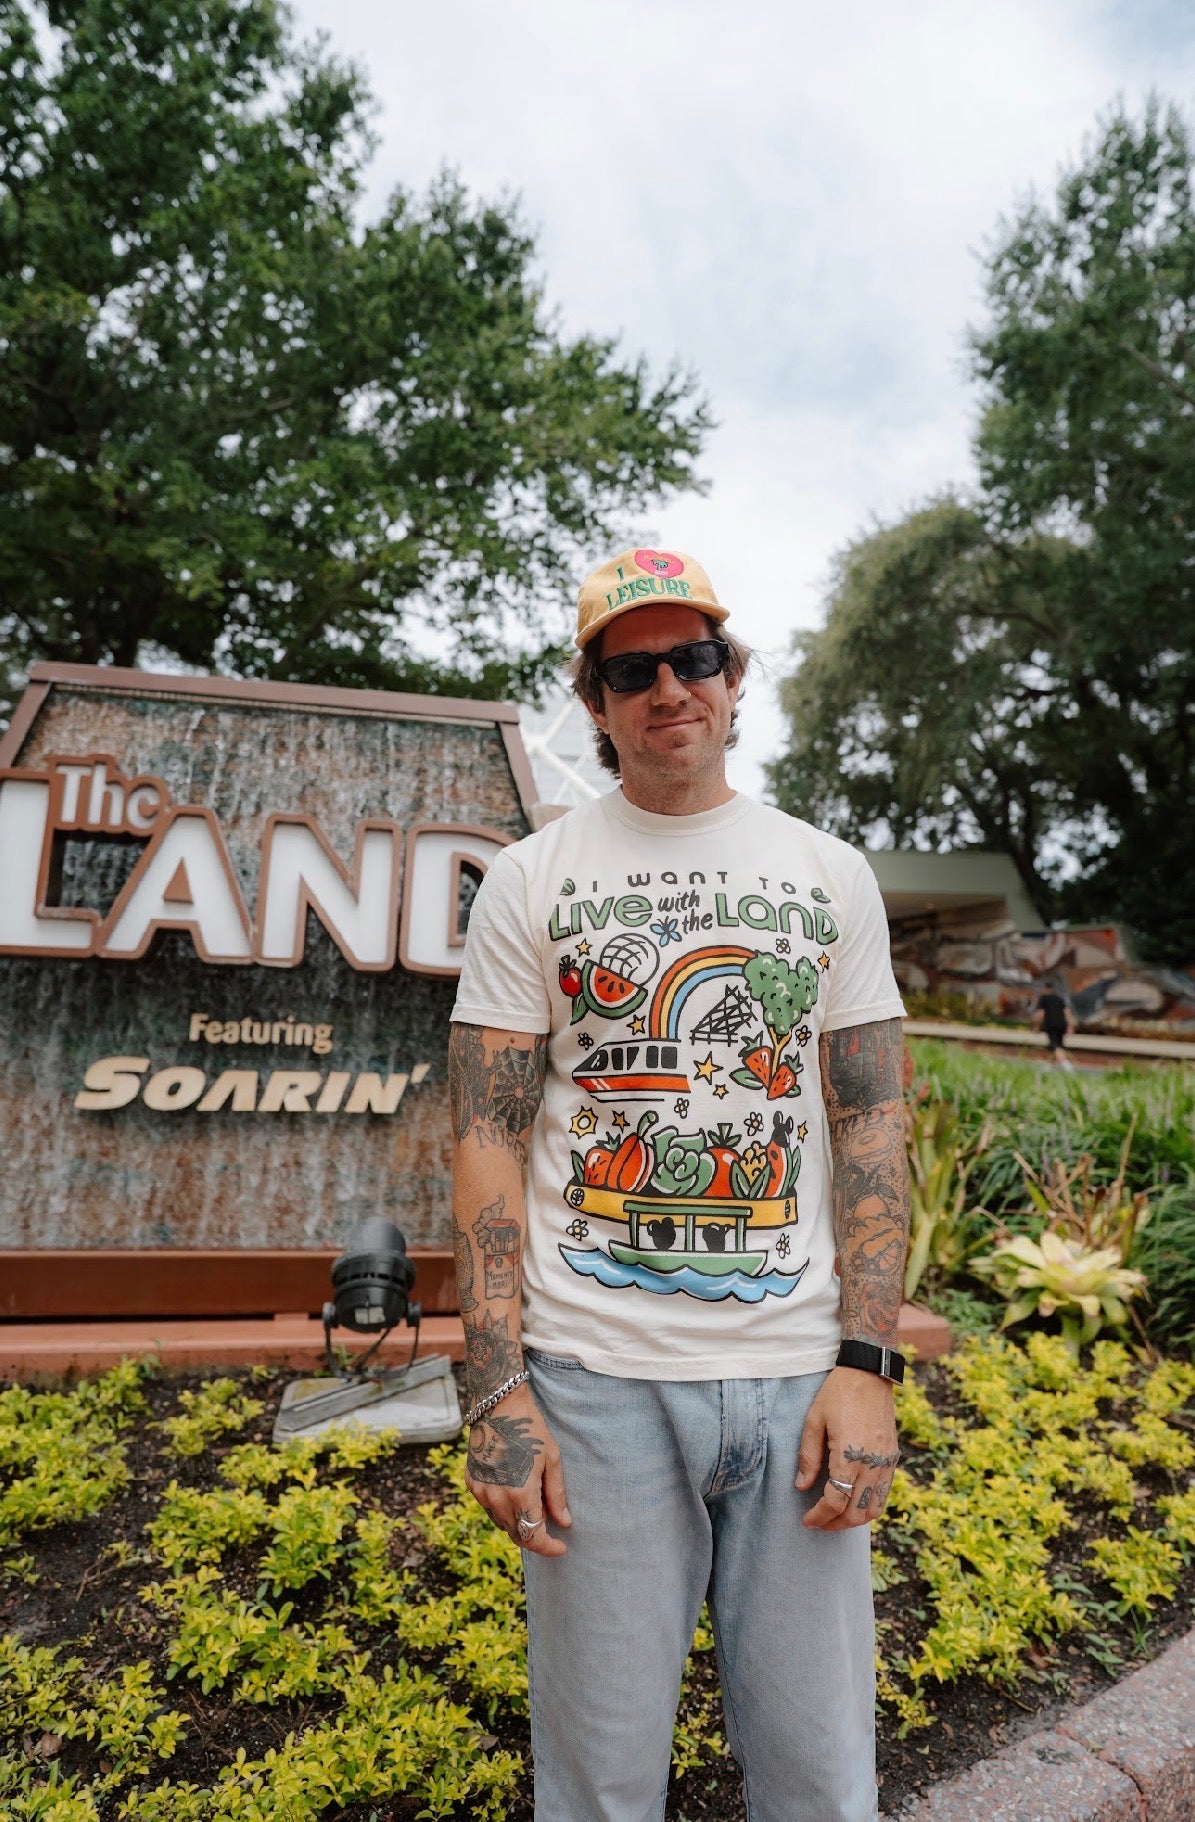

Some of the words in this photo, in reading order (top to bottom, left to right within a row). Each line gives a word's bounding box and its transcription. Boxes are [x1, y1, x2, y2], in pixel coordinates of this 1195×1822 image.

[606, 577, 693, 610] LEISURE
[617, 566, 625, 580] I
[55, 762, 163, 832] The
[592, 881, 598, 893] I
[657, 889, 700, 912] with
[682, 910, 713, 935] the
[189, 1013, 333, 1055] Featuring
[74, 1055, 431, 1114] SOARIN'
